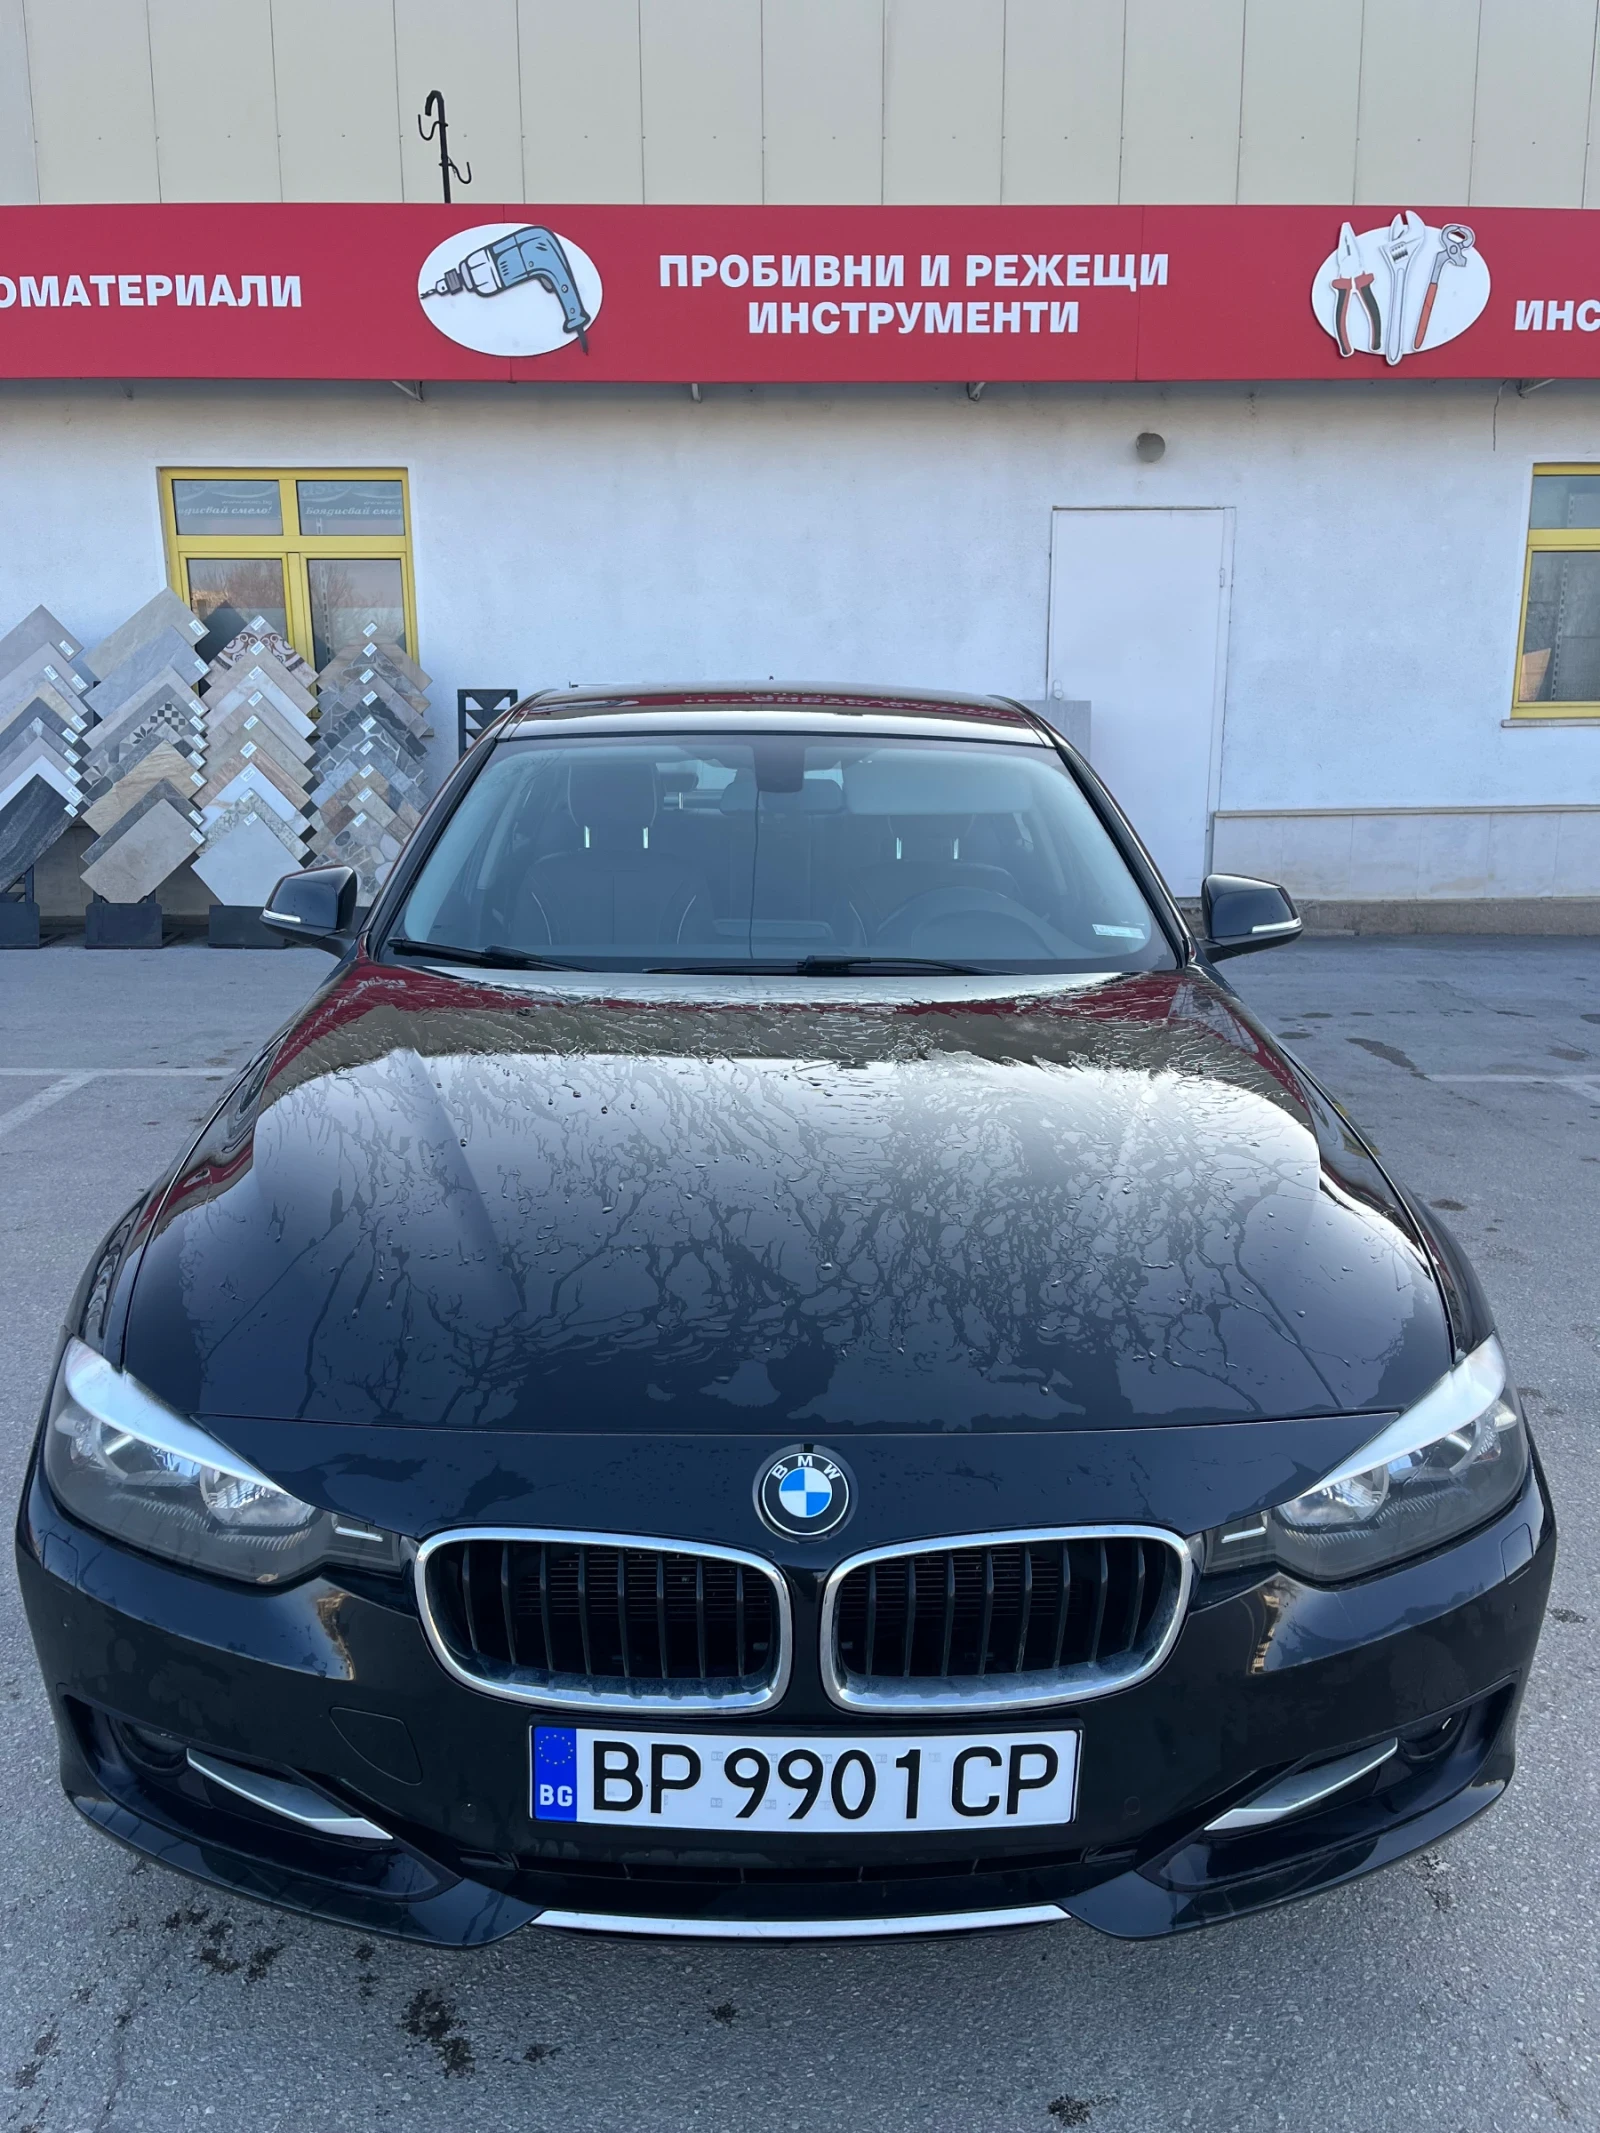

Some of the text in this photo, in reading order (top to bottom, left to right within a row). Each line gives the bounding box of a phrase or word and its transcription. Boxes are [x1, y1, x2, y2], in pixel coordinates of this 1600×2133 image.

[659, 253, 1169, 292] ПРОБИВНИ И РЕЖЕЩИ
[748, 301, 1079, 335] ИНСТРУМЕНТИ
[1514, 299, 1600, 332] ИНС
[771, 1455, 841, 1480] BMW
[539, 1783, 573, 1807] BG
[724, 1748, 921, 1820] 9901
